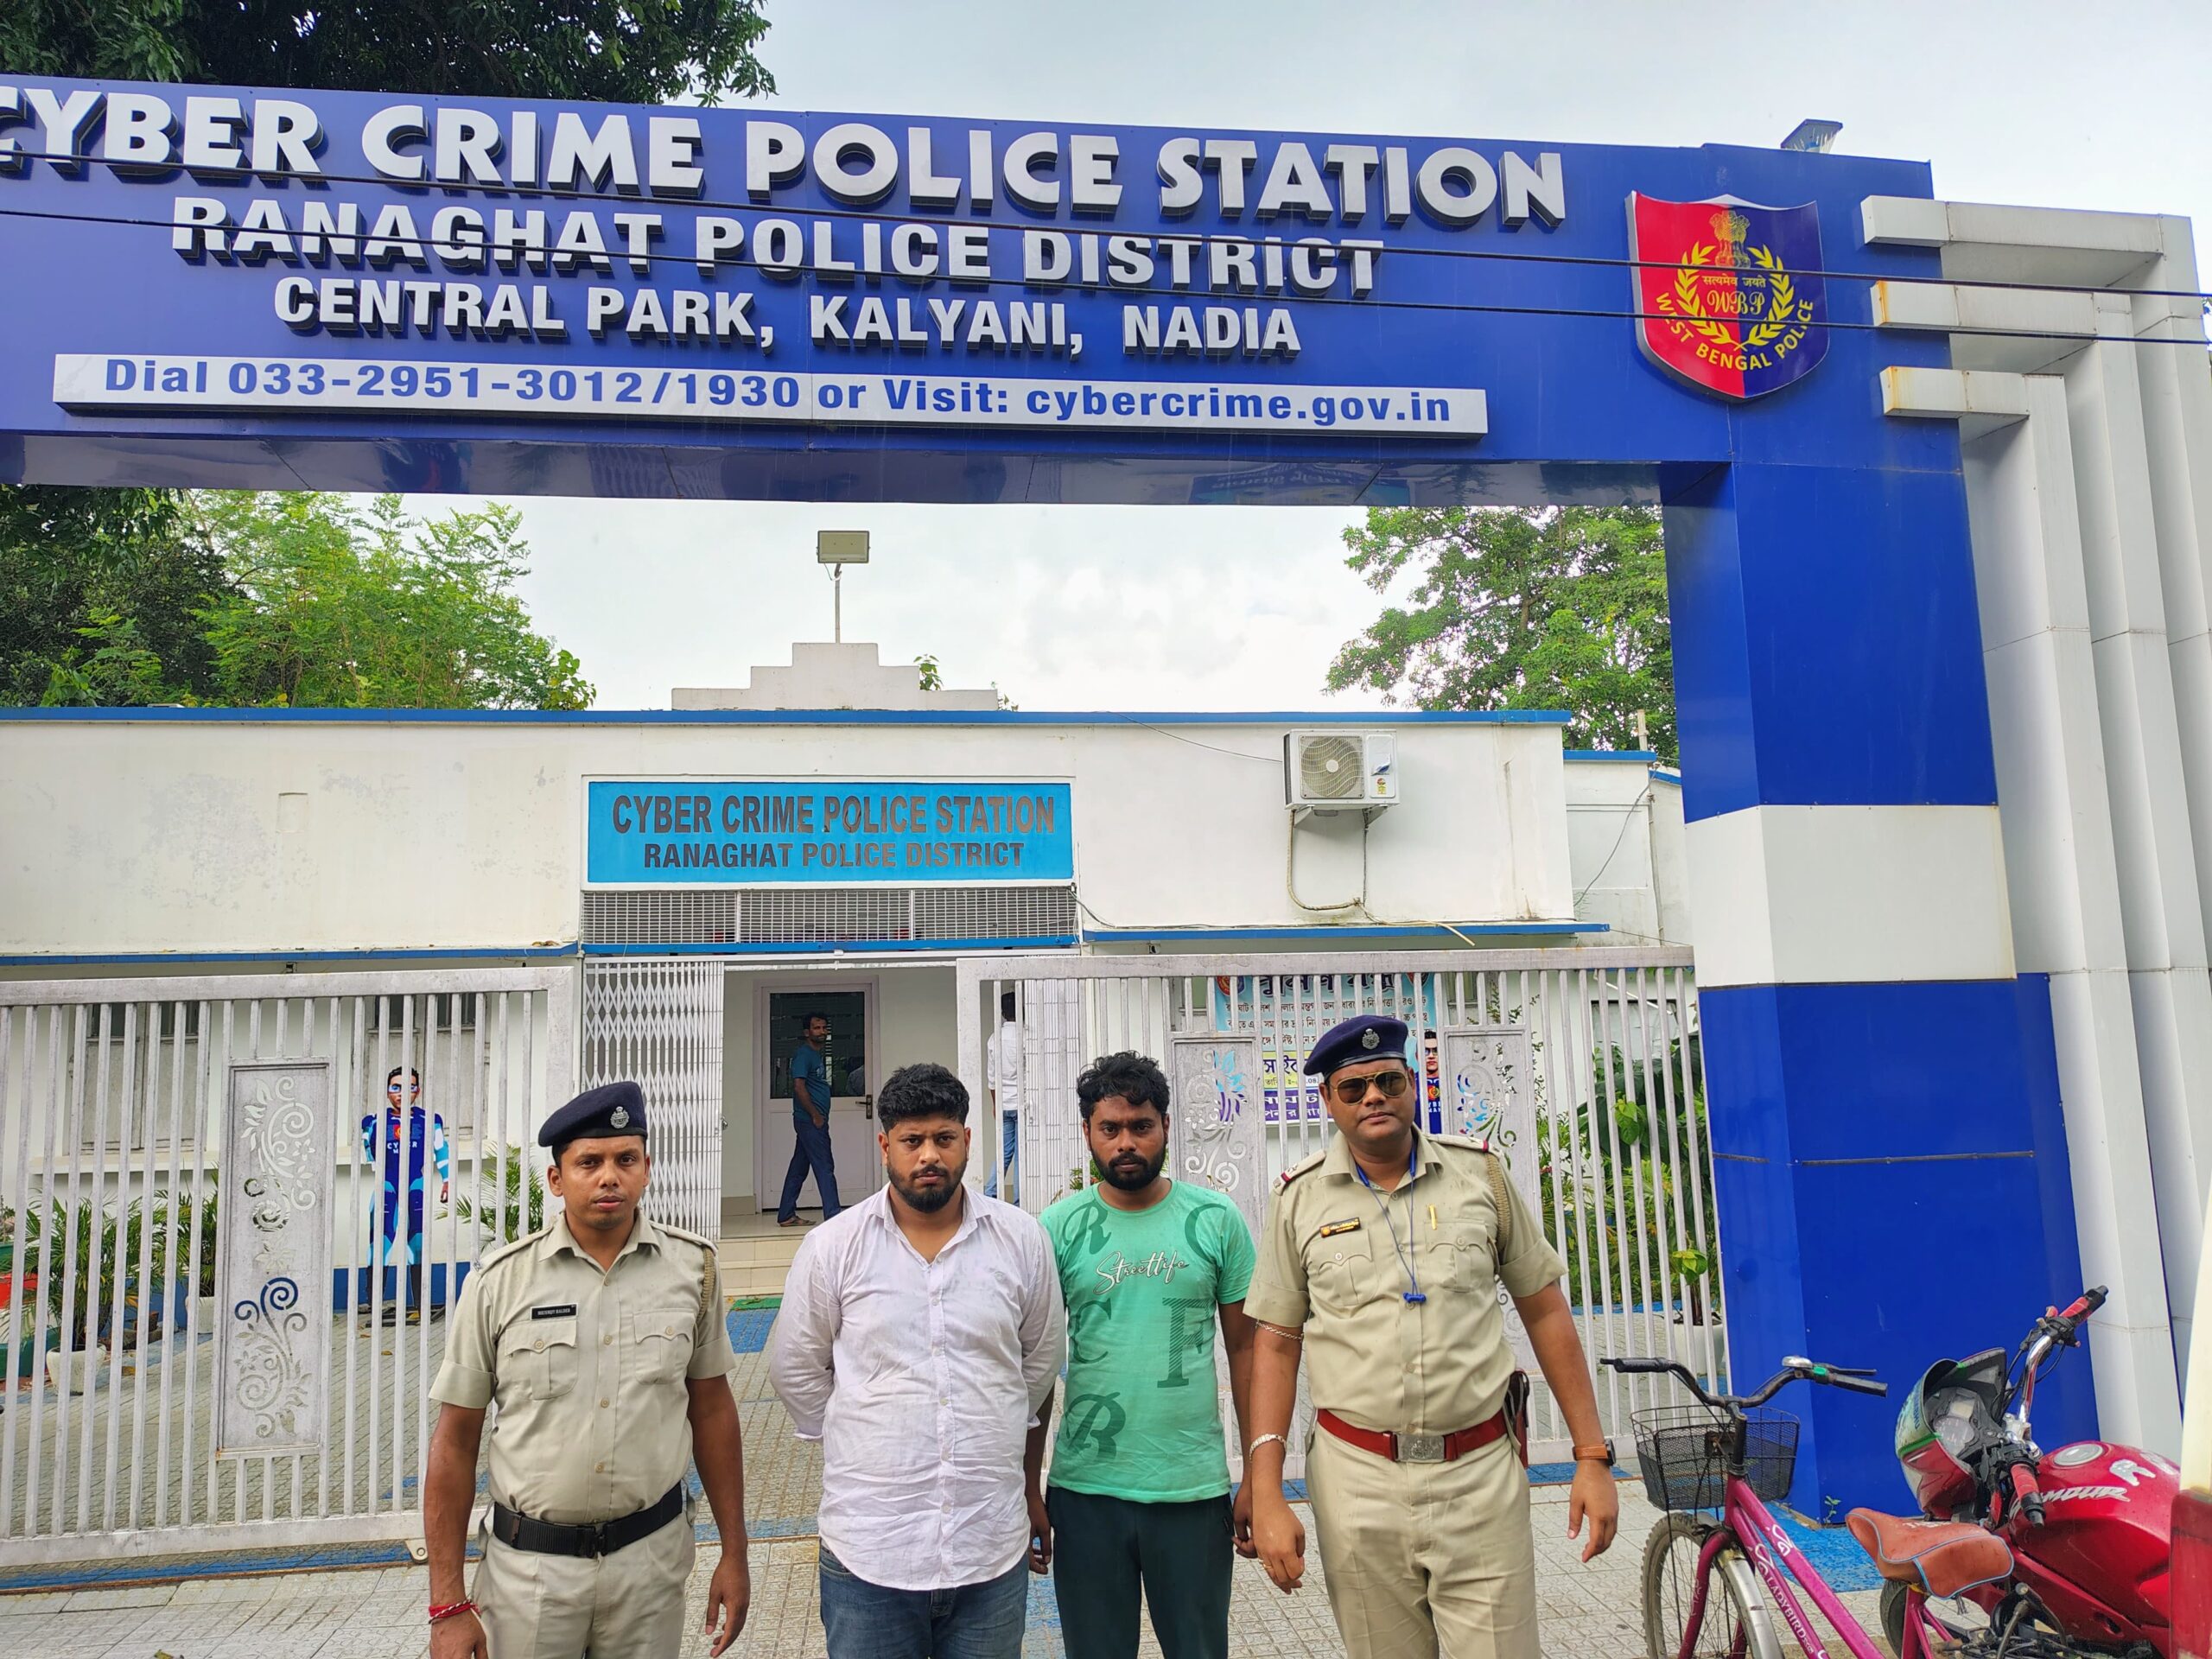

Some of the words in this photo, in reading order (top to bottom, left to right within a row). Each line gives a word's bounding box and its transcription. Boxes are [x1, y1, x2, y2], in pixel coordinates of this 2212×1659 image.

[362, 105, 706, 190] CRIME
[747, 121, 1124, 208] POLICE
[1155, 138, 1566, 223] STATION
[172, 196, 663, 270] RANAGHAT
[696, 217, 991, 279] POLICE
[1023, 230, 1384, 295] DISTRICT
[1742, 274, 1766, 288] जयते
[275, 276, 565, 332] CENTRAL
[588, 287, 773, 348] PARK,
[810, 295, 1083, 356] KALYANI,
[1123, 305, 1301, 353] NADIA
[1695, 342, 1772, 371] BENGAL
[105, 359, 207, 393] Dial
[228, 362, 799, 408] 033-2951-3012/1930
[817, 384, 867, 410] or
[882, 378, 1007, 413] Visit:
[1026, 385, 1450, 427] cybercrime.gov.in
[613, 795, 712, 834] CYBER
[721, 795, 813, 834] CRIME
[823, 796, 927, 835] POLICE
[936, 795, 1055, 834] STATION
[644, 842, 793, 868] RANAGHAT
[802, 842, 895, 868] POLICE
[906, 842, 1025, 868] DISTRICT
[387, 1141, 418, 1149] CYR
[1766, 1576, 1808, 1640] LADYBIRD
